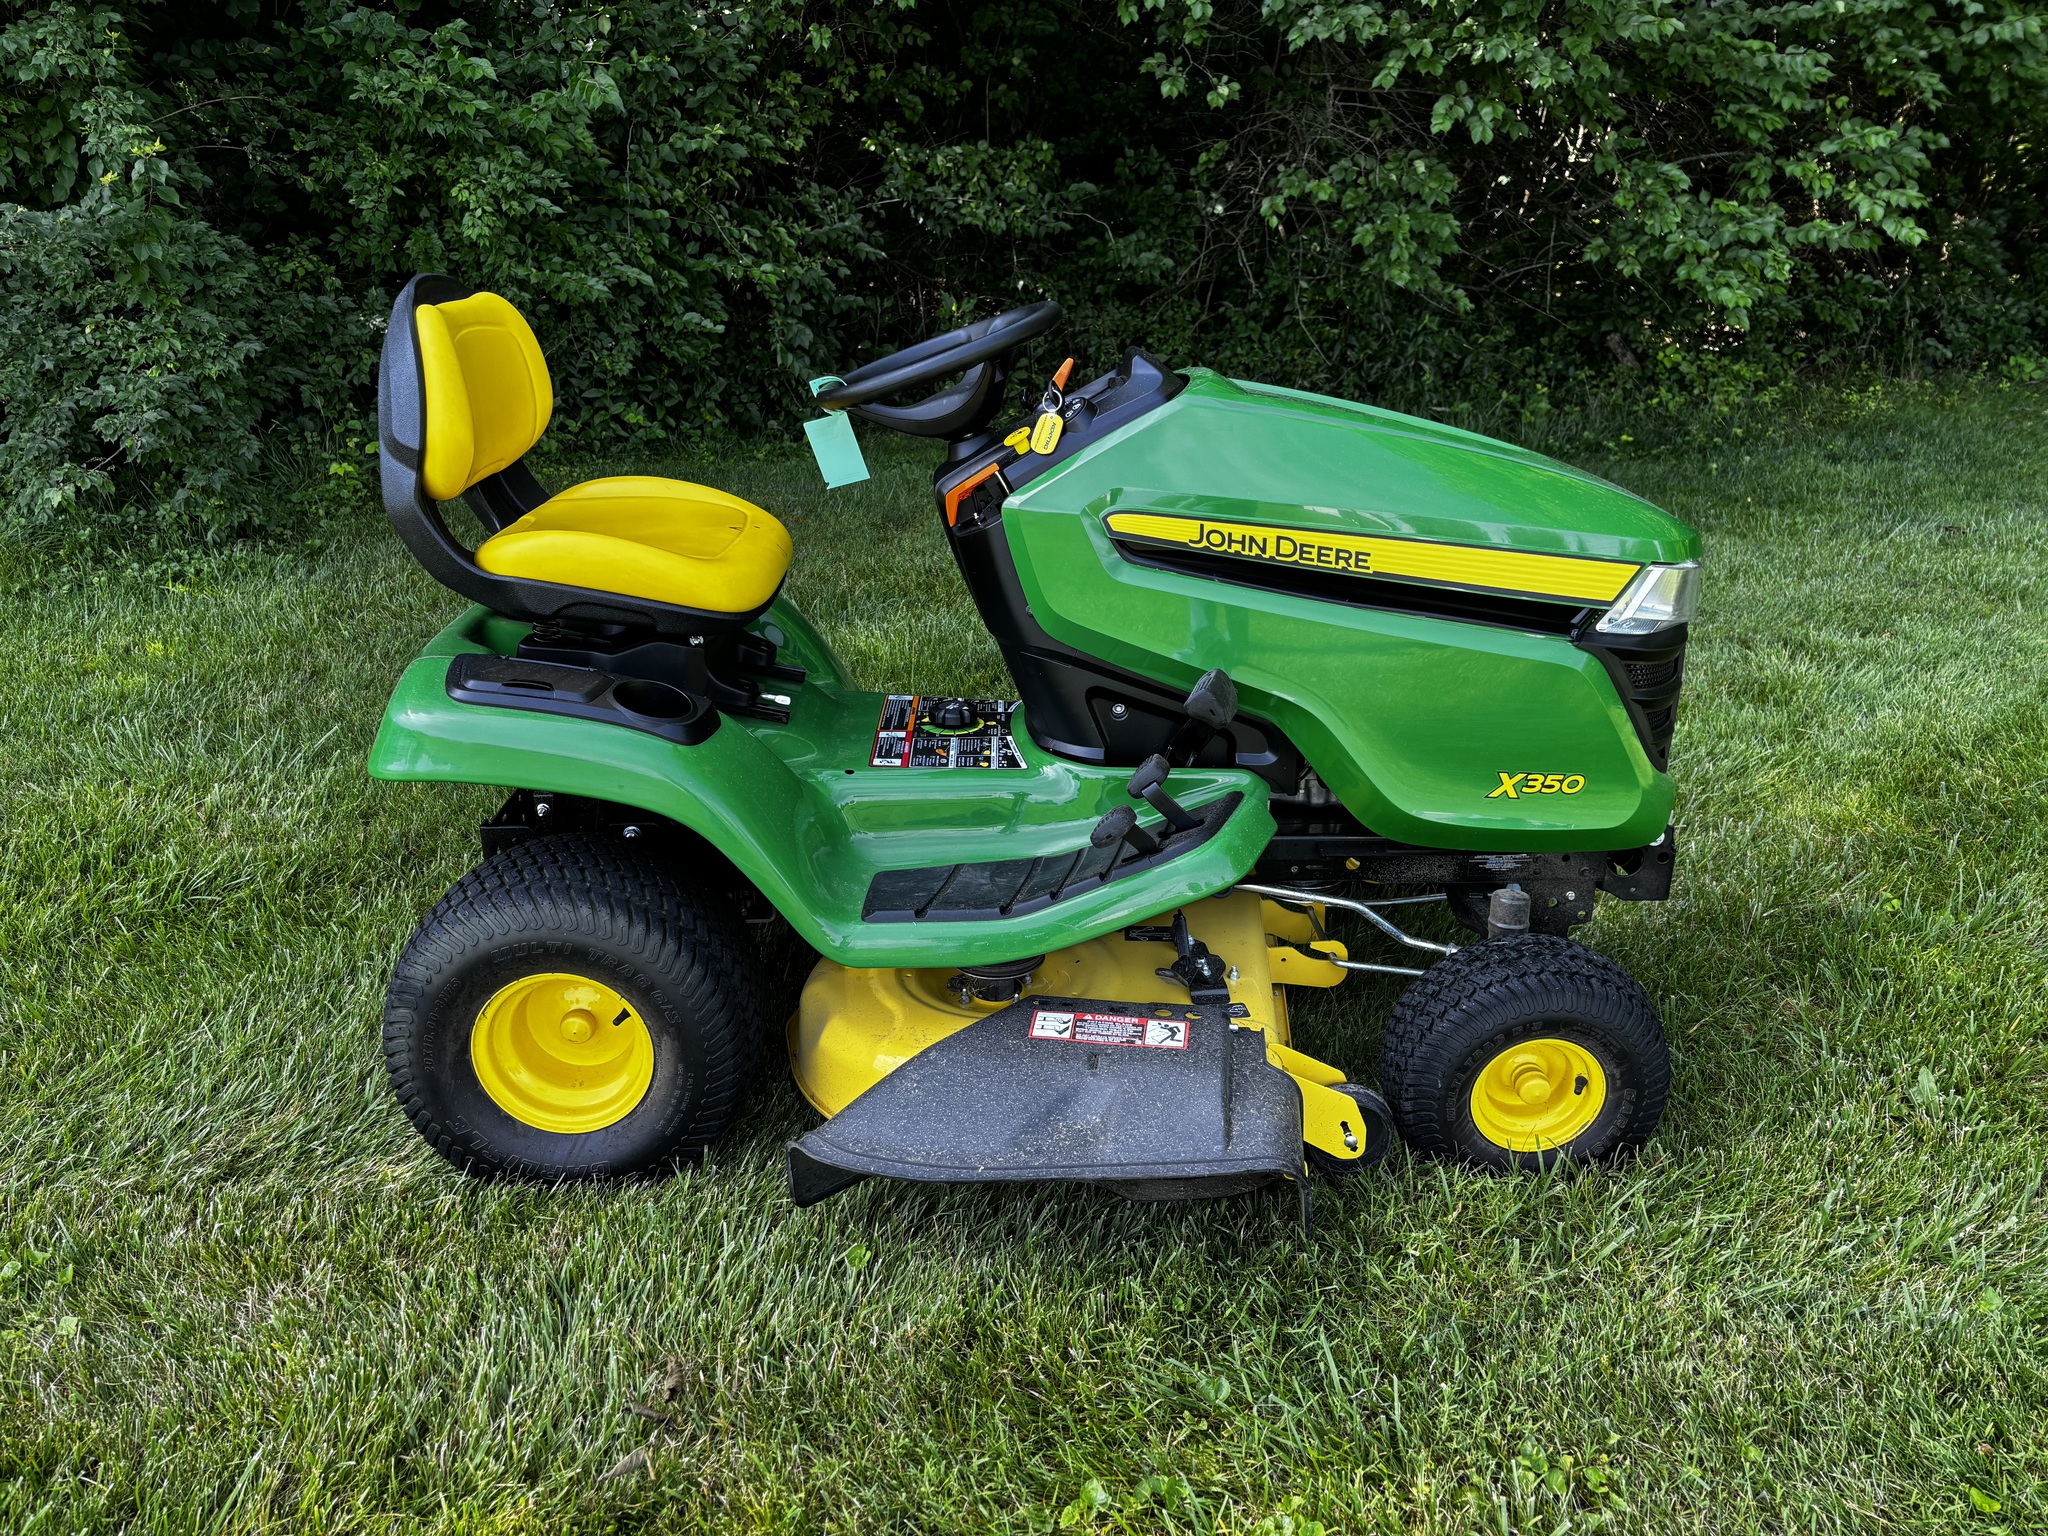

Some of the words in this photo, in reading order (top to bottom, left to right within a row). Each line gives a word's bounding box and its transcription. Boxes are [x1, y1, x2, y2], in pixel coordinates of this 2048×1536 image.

[1188, 523, 1268, 556] JOHN
[1275, 535, 1372, 570] DEERE
[1484, 771, 1587, 799] X350
[489, 940, 574, 963] MULTI
[588, 946, 653, 989] TRAC
[1094, 1014, 1139, 1024] DANGER
[1445, 1072, 1467, 1122] MULTI
[445, 1114, 612, 1181] CARLISLE
[1578, 1087, 1637, 1160] CARLIS
